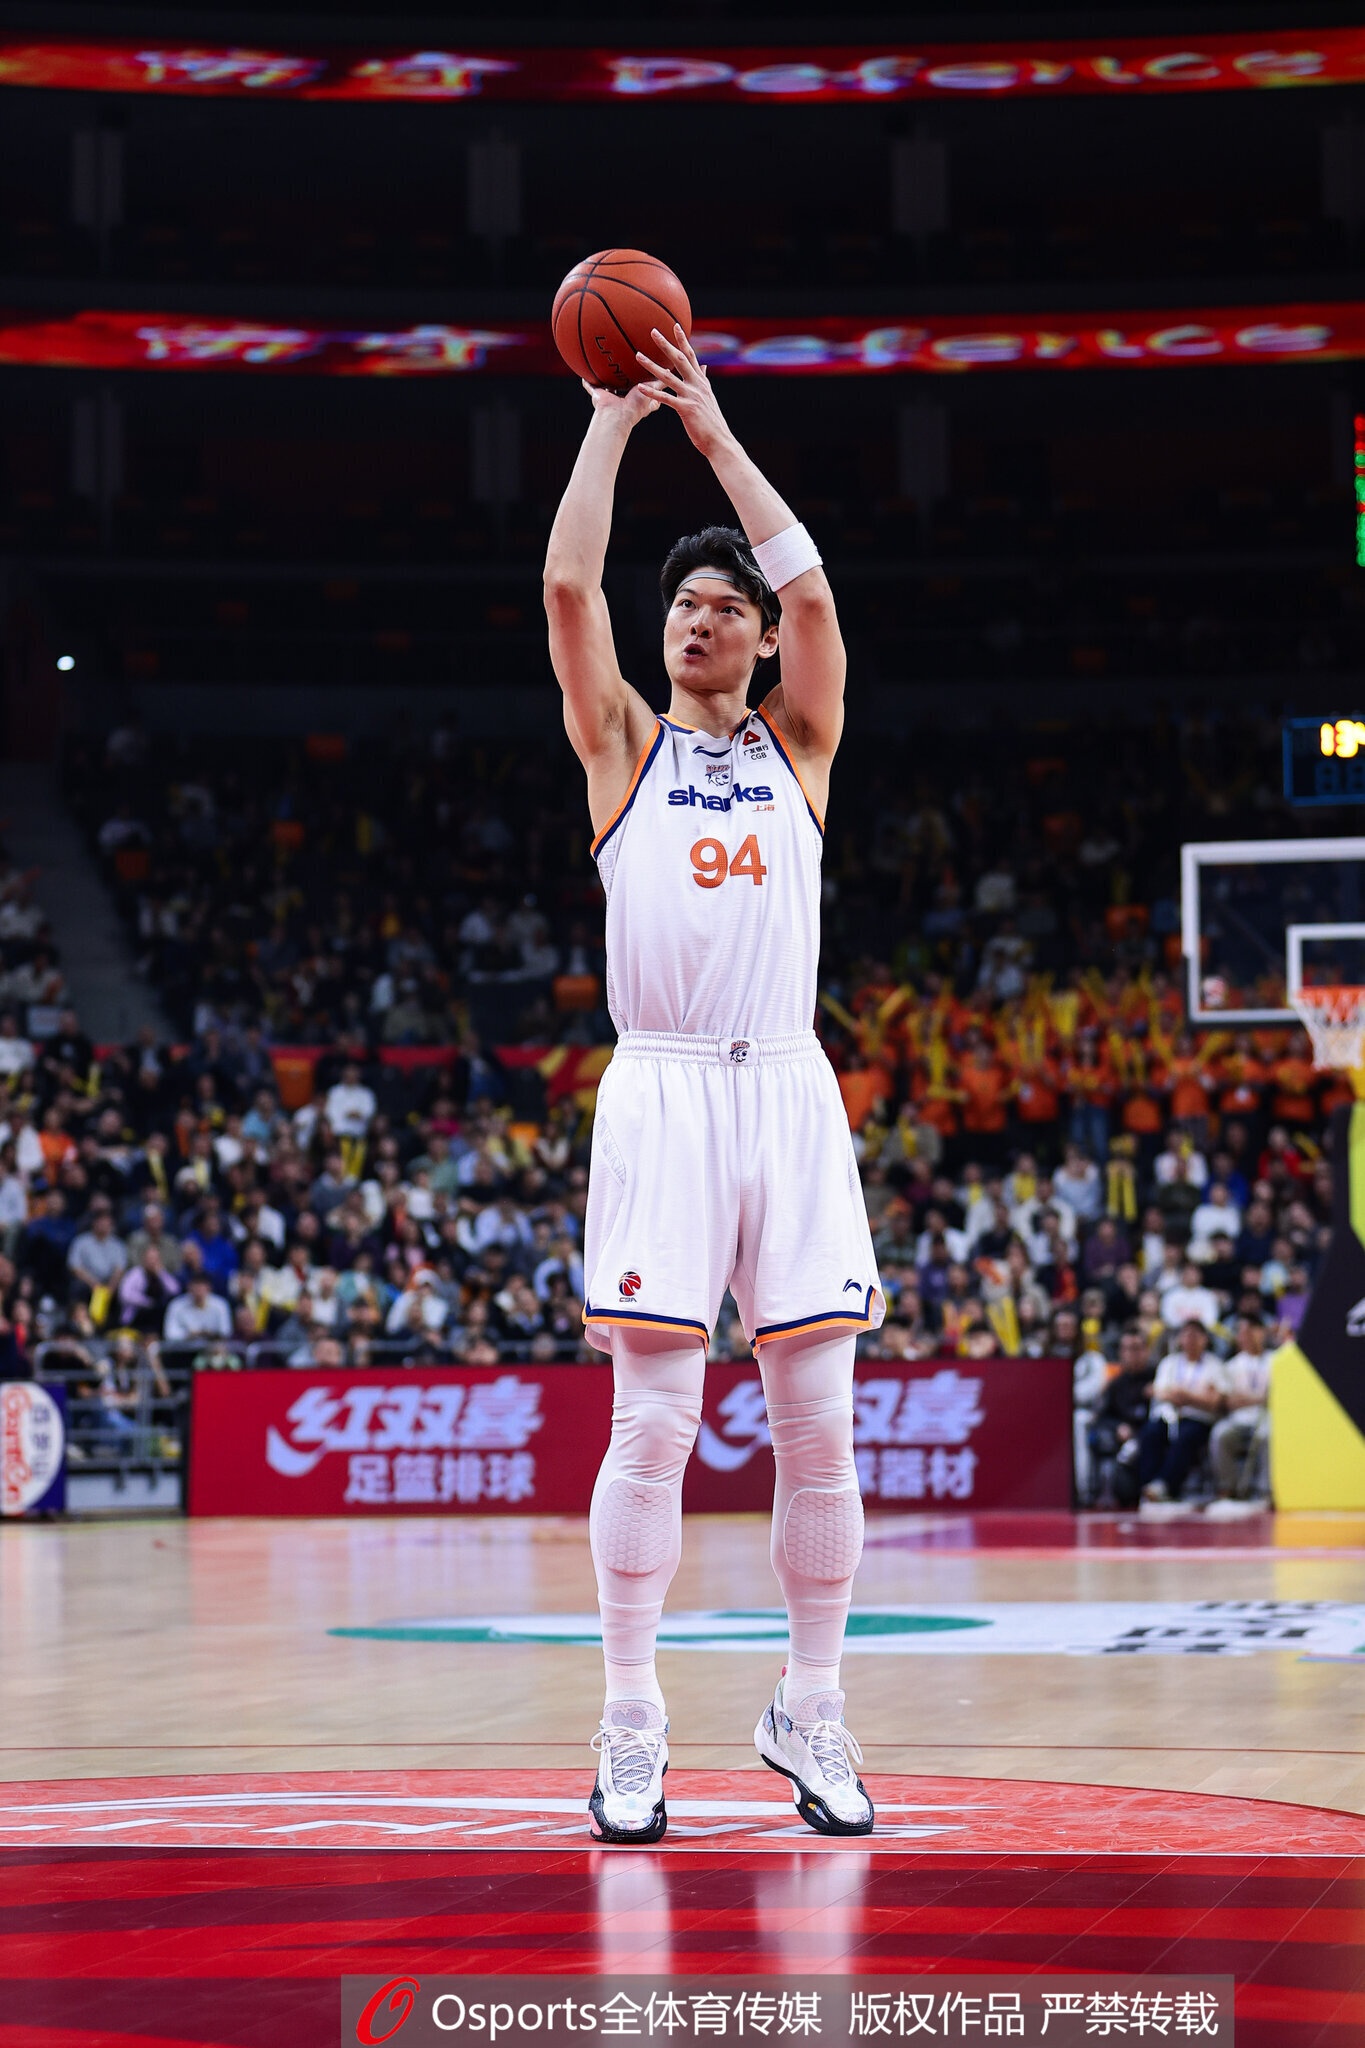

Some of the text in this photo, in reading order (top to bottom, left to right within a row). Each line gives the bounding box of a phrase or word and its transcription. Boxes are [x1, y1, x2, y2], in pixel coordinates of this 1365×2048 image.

[751, 752, 767, 760] CGB
[668, 783, 774, 812] sharks
[690, 834, 767, 889] 94
[266, 1375, 545, 1478] 红双喜
[344, 1451, 536, 1503] 足篮排球
